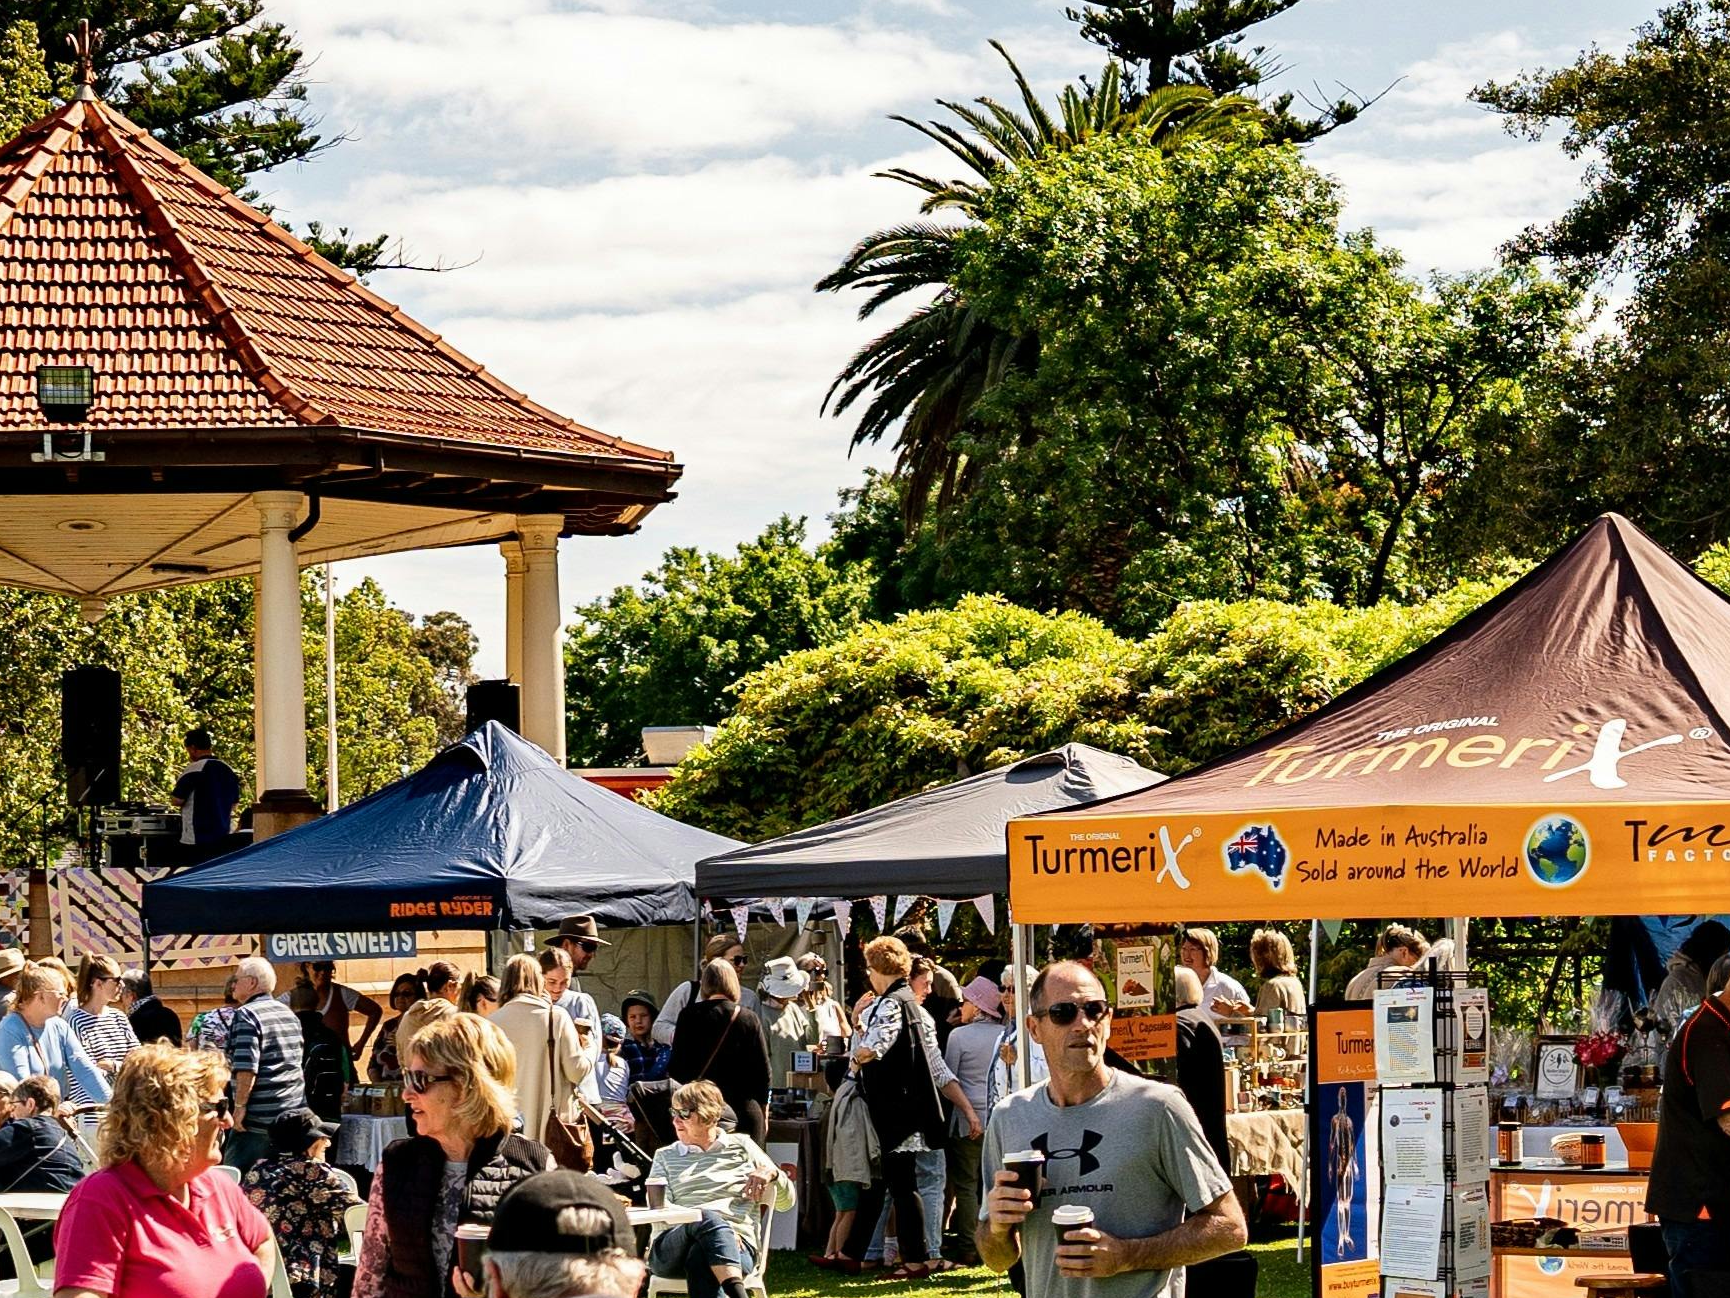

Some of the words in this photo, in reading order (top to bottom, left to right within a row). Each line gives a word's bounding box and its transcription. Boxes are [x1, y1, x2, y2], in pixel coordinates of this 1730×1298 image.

[1375, 726, 1414, 743] THE
[1413, 715, 1500, 735] ORIGINAL
[1243, 718, 1684, 789] TurmeriX
[1069, 833, 1084, 842] THE
[1086, 832, 1121, 841] ORIGINAL
[1315, 827, 1370, 849] Made
[1380, 824, 1397, 847] in
[1404, 822, 1488, 848] Australia
[1024, 825, 1194, 889] TurmeriX
[1295, 860, 1338, 883] Sold
[1346, 859, 1406, 882] around
[1414, 857, 1450, 880] the
[1458, 854, 1519, 880] World
[390, 902, 437, 917] RIDGE
[440, 901, 493, 916] RYDER
[271, 932, 334, 957] GREEK
[333, 931, 413, 955] SWEETS
[1335, 1031, 1374, 1054] Turmer
[1060, 1184, 1113, 1195] ARMOUR
